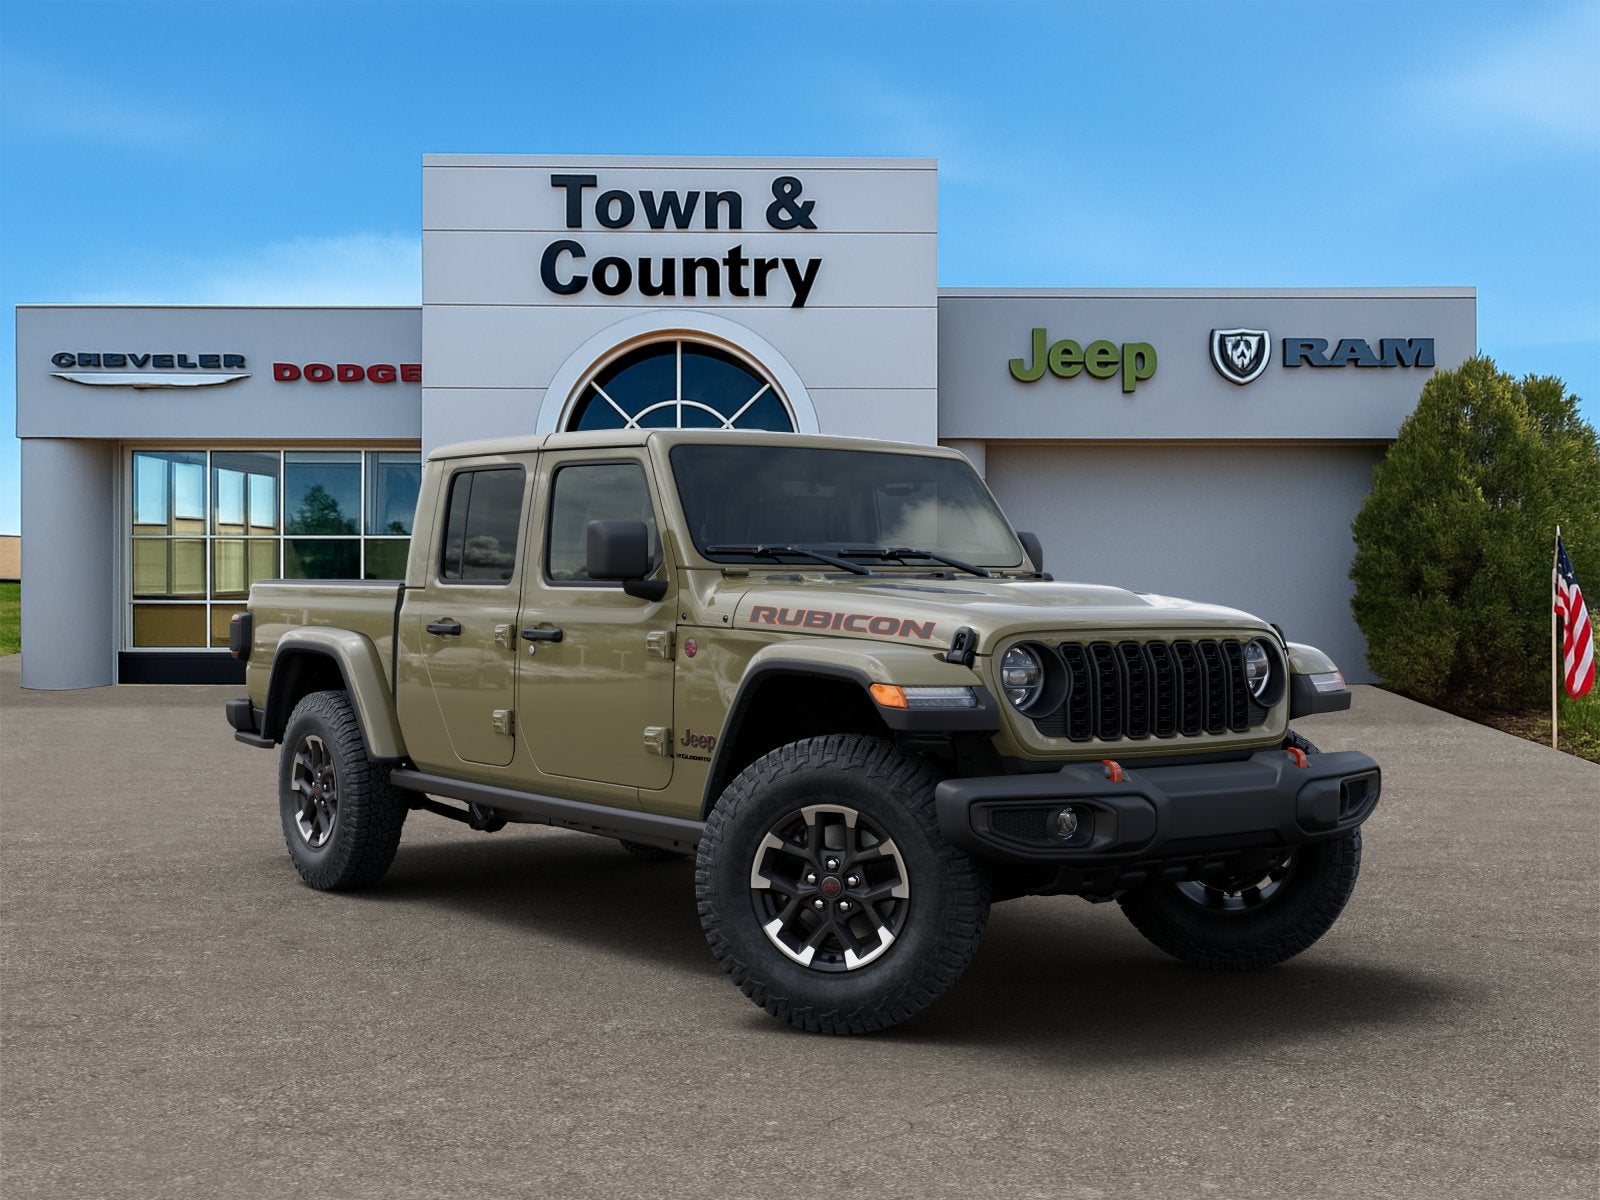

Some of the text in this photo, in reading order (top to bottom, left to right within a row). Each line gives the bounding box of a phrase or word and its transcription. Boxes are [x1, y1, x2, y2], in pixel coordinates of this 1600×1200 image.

[551, 174, 818, 229] Town &
[540, 239, 822, 308] Country
[1009, 328, 1157, 392] Jeep
[1283, 337, 1436, 368] RAM
[272, 362, 422, 383] DODGE
[750, 605, 936, 640] RUBICON
[680, 727, 716, 753] Jeep
